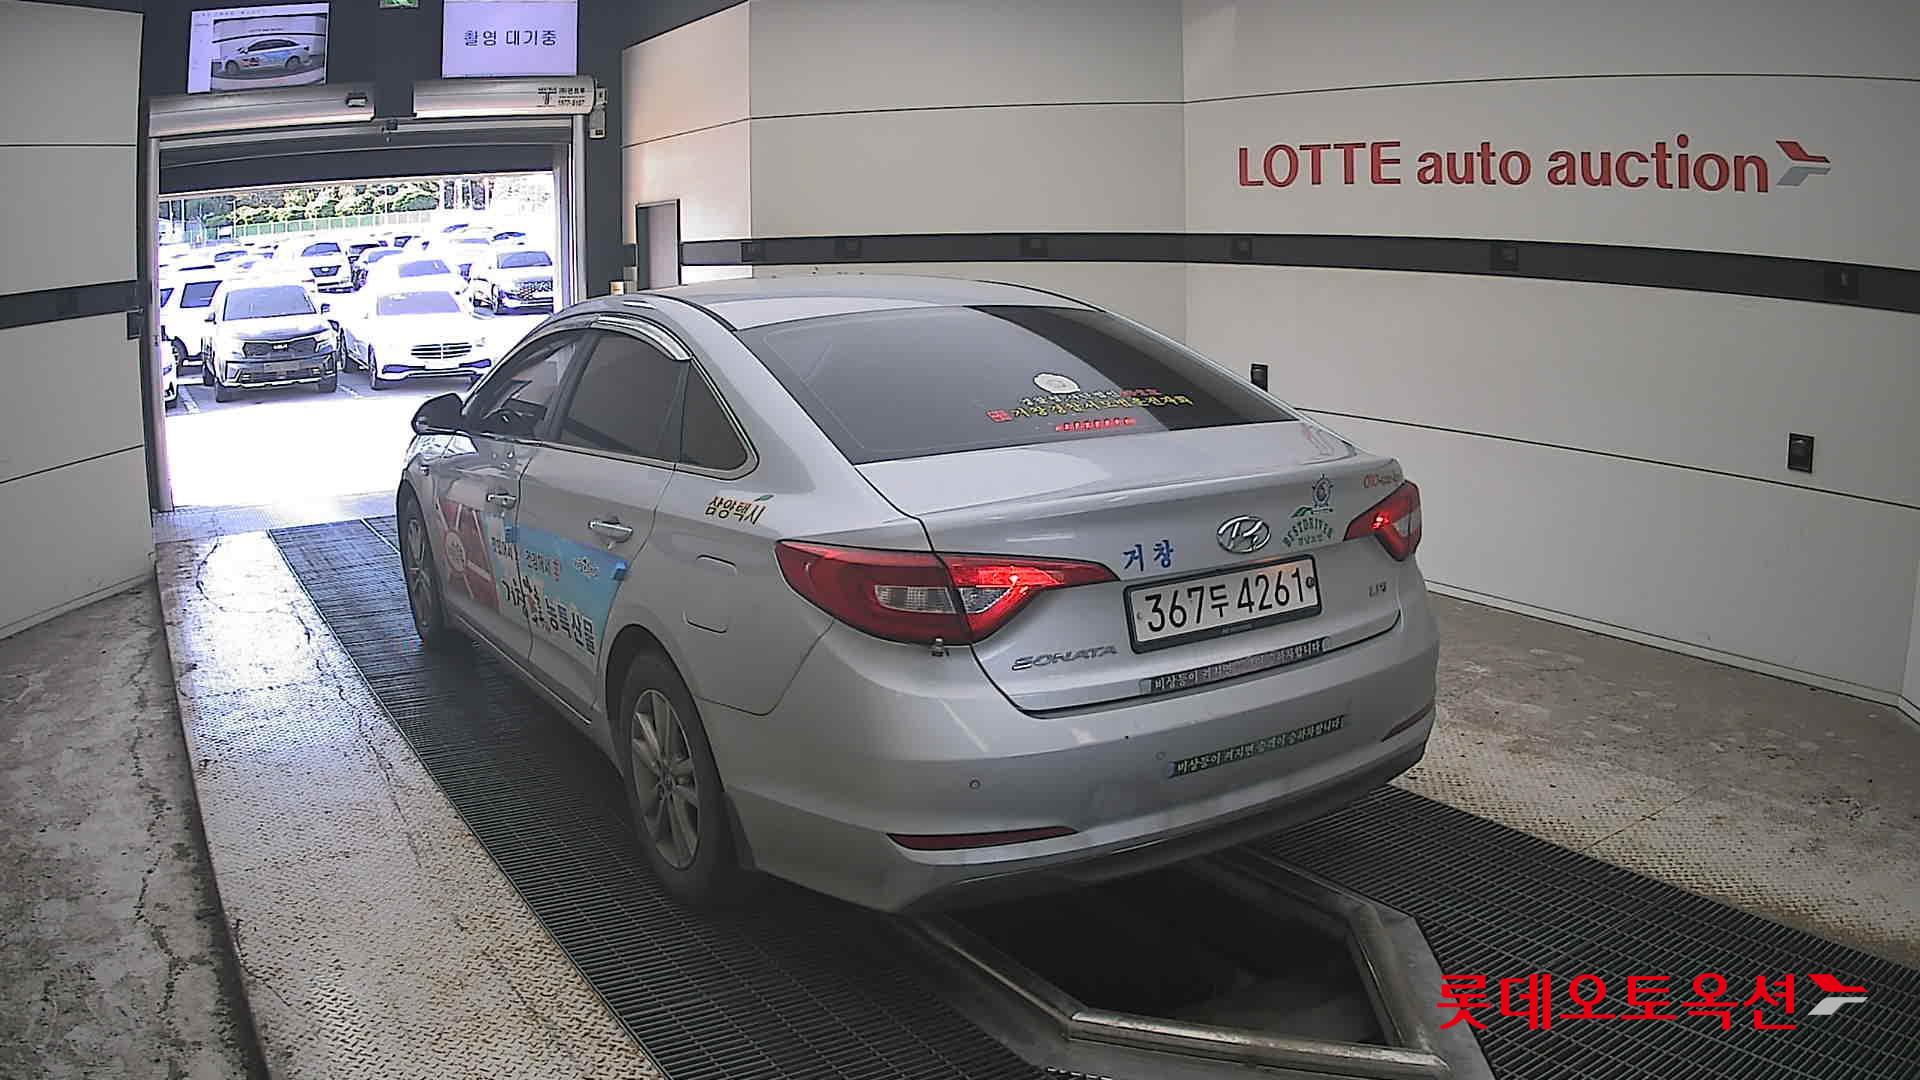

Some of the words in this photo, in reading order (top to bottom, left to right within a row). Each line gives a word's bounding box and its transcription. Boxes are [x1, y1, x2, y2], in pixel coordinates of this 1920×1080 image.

[464, 30, 497, 47] 촬영
[505, 30, 557, 46] 대기중
[1239, 140, 1400, 187] LOTTE
[1416, 141, 1531, 186] auto
[1547, 134, 1769, 193] auction
[705, 496, 766, 525] 삼양택시
[1123, 540, 1175, 573] 거창
[1144, 584, 1230, 632] 367두
[1237, 567, 1306, 612] 4261
[1012, 645, 1118, 671] SONATA
